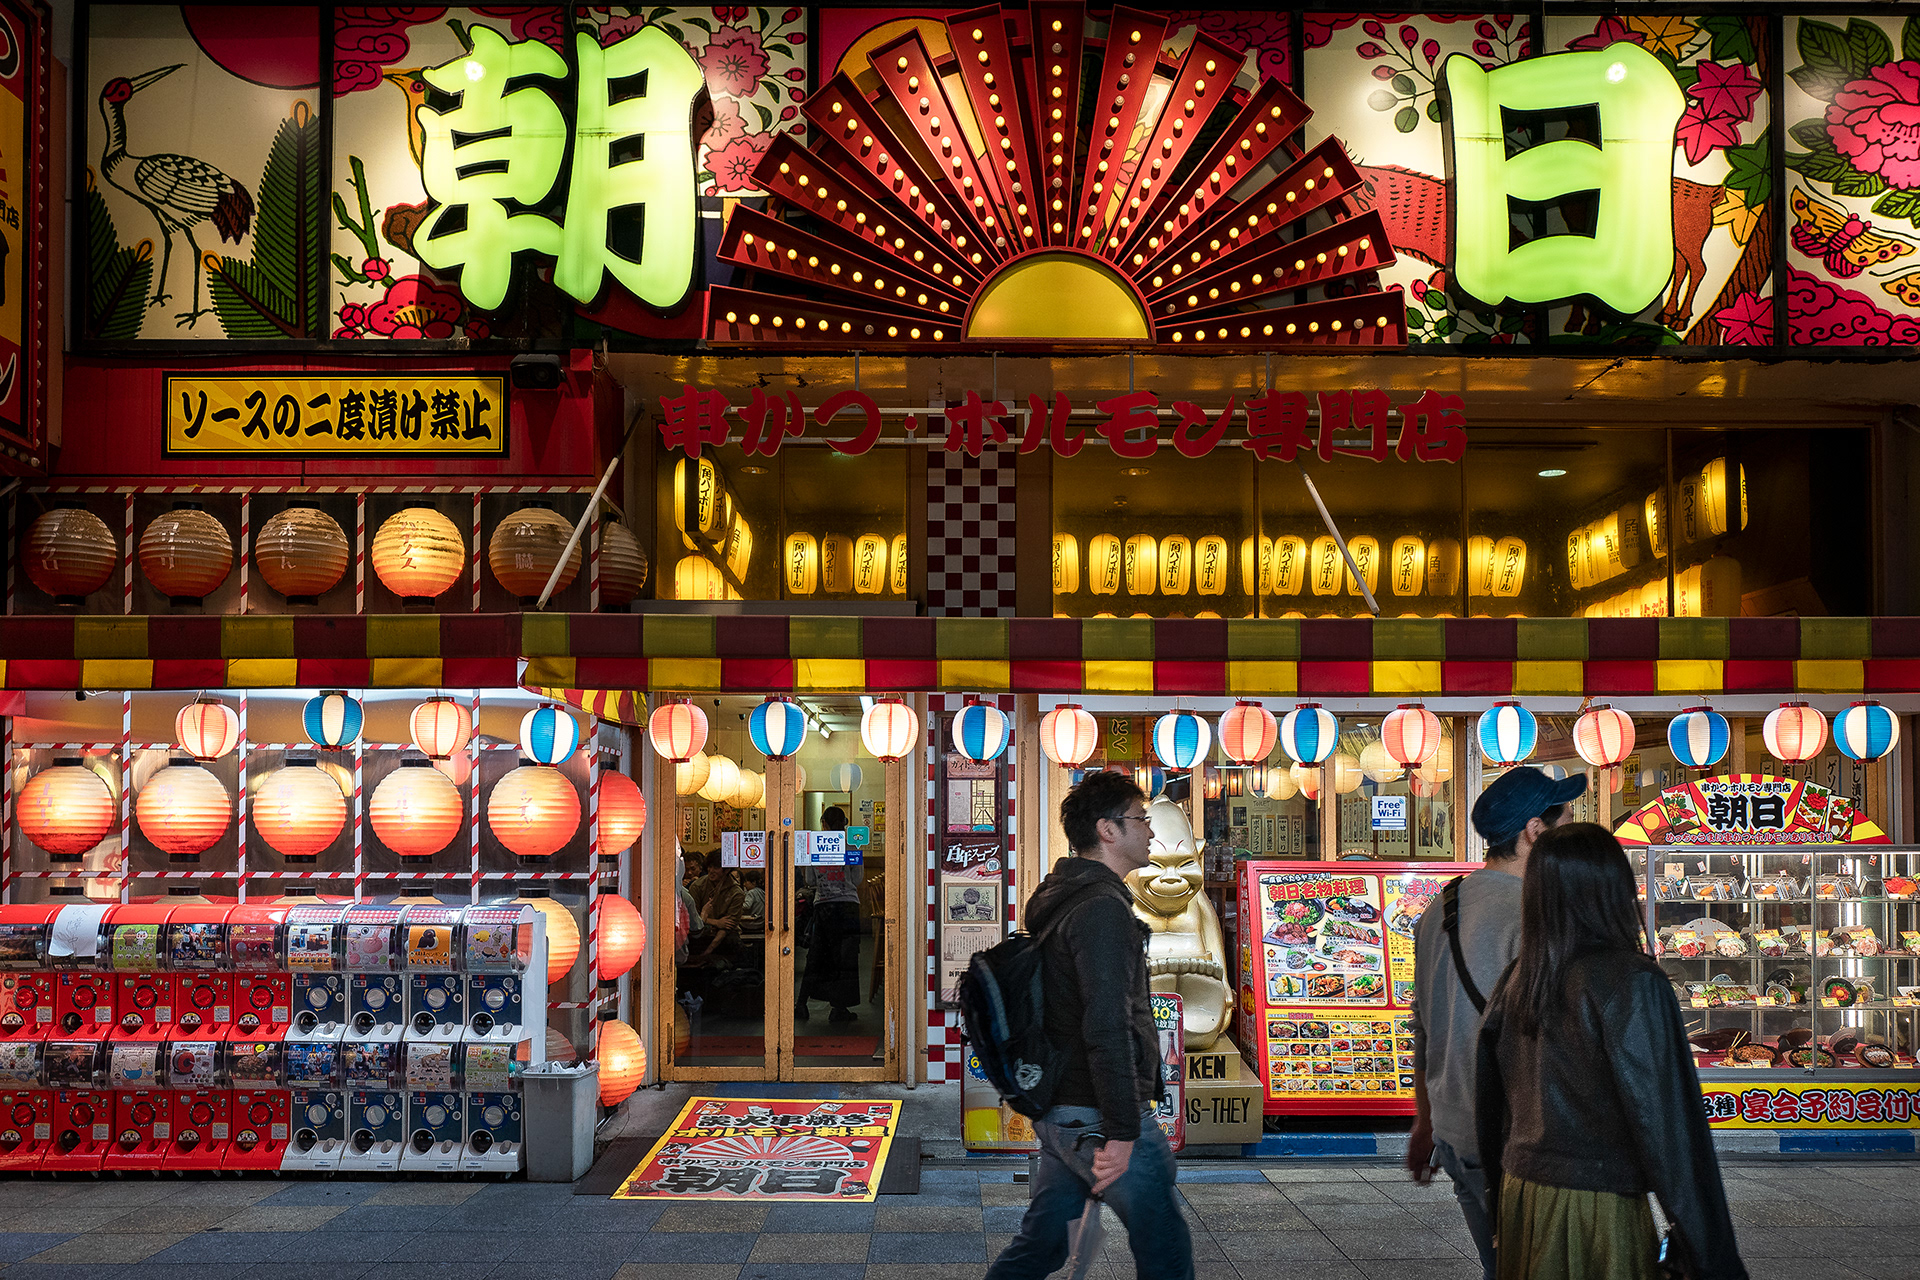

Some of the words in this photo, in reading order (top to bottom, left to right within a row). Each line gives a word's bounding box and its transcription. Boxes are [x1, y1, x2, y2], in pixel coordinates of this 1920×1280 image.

[410, 23, 709, 314] 朝
[1444, 39, 1687, 315] 日
[180, 389, 492, 442] ソースの二度漬け禁止
[659, 384, 1467, 461] 串かつ・ホルモン専門店
[794, 542, 805, 588] 角ハイボール
[859, 542, 875, 588] 角ハイボール
[1105, 543, 1119, 588] 角ハイボール
[1166, 543, 1181, 588] 角ハイボール
[1204, 543, 1218, 588] 角ハイボール
[1277, 543, 1293, 587] 角ハイボール
[1321, 543, 1336, 588] 角ハイボール
[1399, 544, 1414, 591] 角ハイボール
[1501, 544, 1520, 592] 角ハイボール
[1112, 719, 1128, 754] にく
[1378, 801, 1400, 809] Free
[1708, 794, 1786, 830] 朝日
[816, 835, 840, 844] Free
[817, 844, 840, 852] Wi-Fi
[946, 843, 999, 867] 百年スコープ
[1269, 879, 1367, 901] 朝日名物料理
[1186, 1056, 1227, 1080] KEN
[675, 1127, 890, 1137] ホルモン料理
[655, 1168, 850, 1195] 朝日
